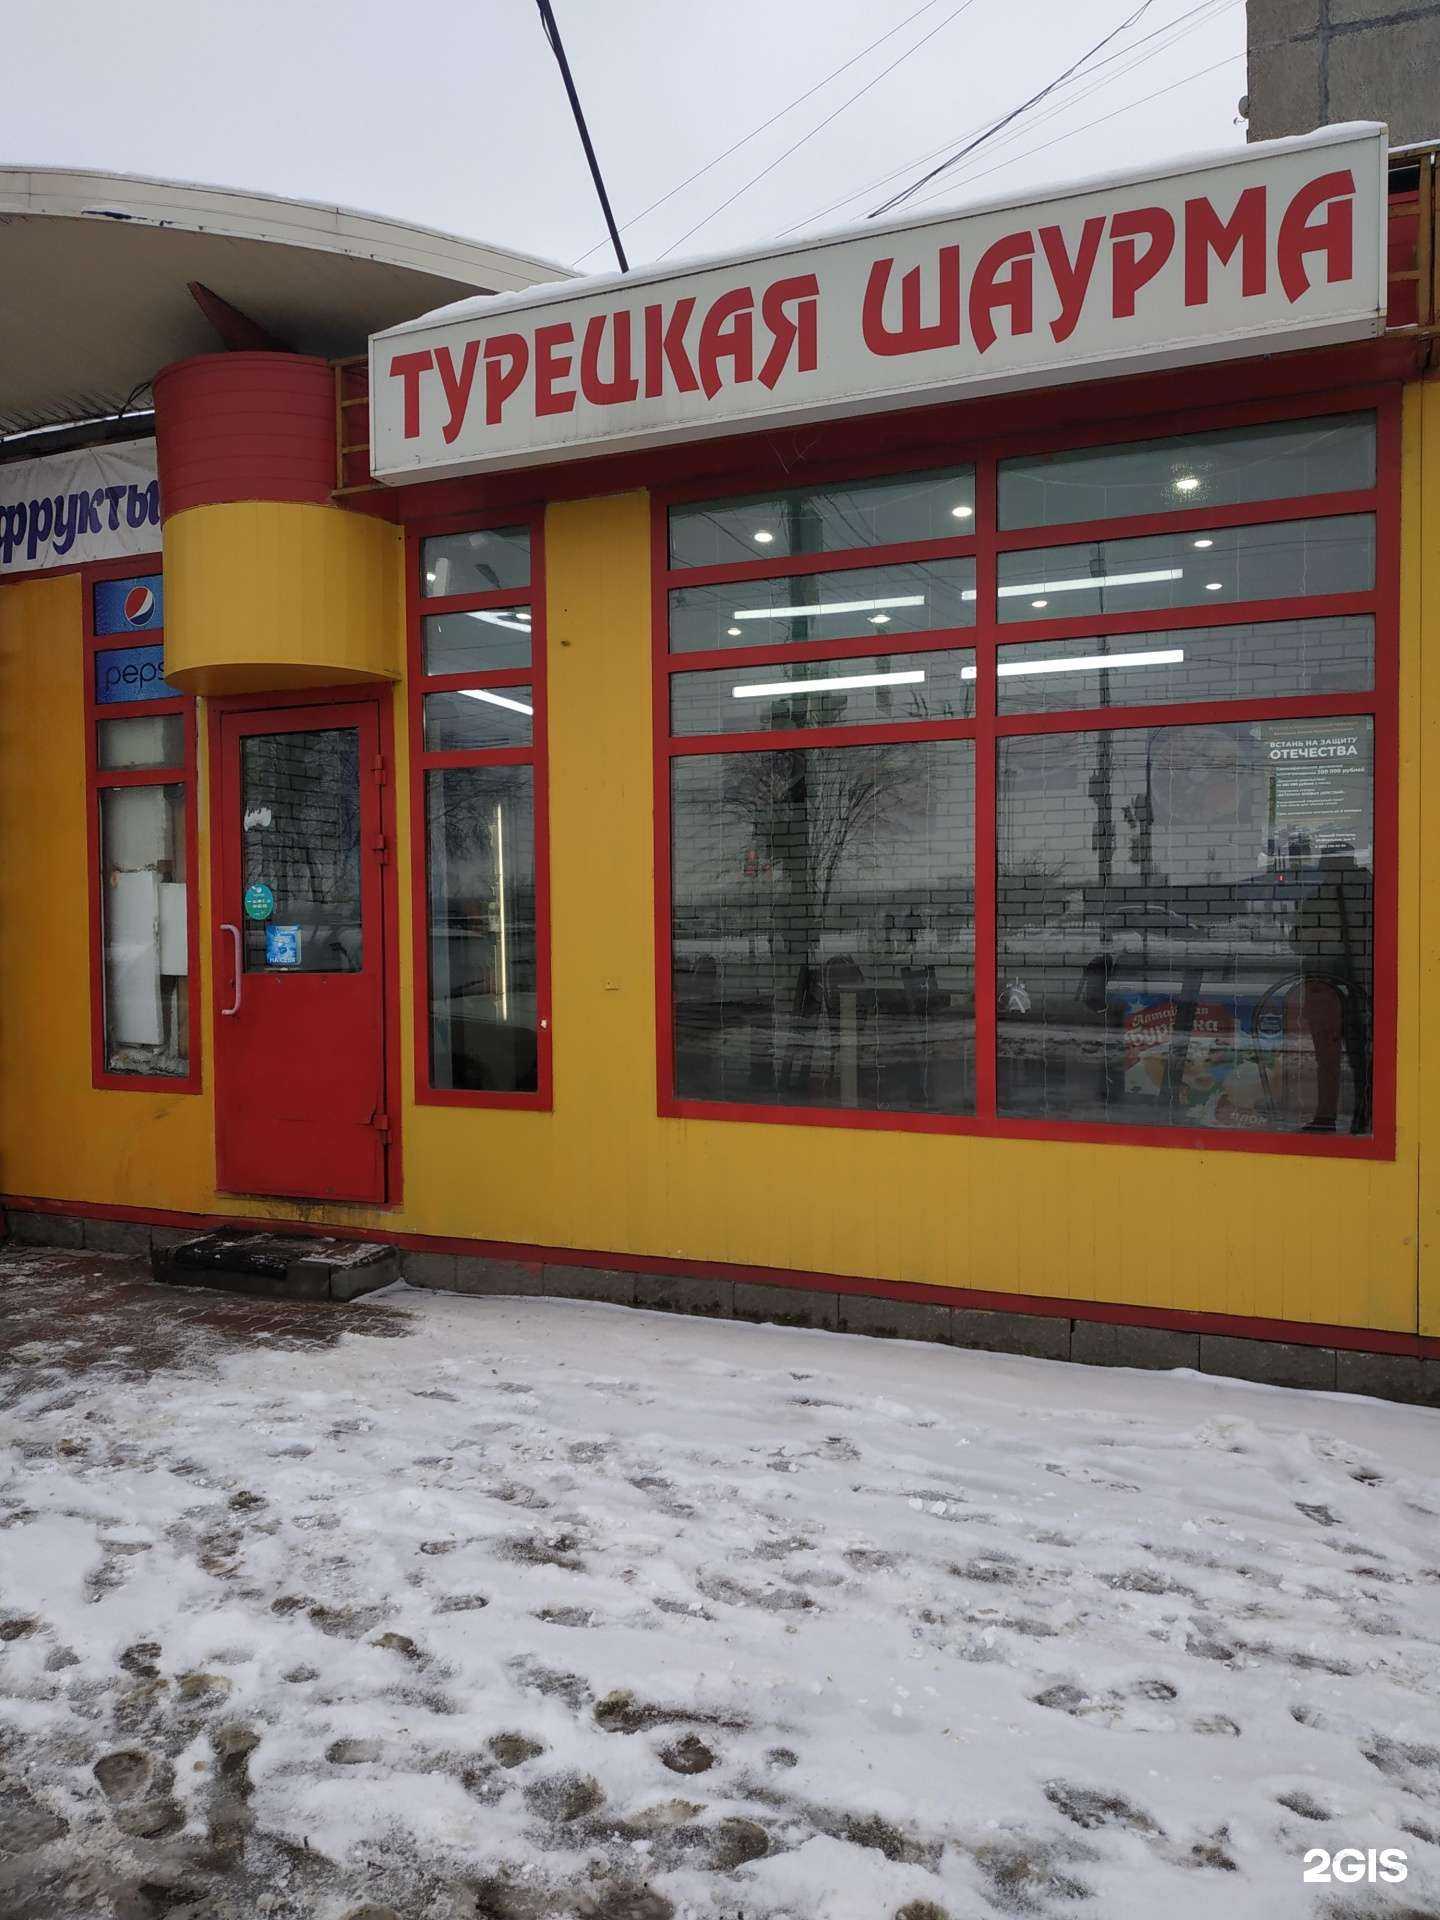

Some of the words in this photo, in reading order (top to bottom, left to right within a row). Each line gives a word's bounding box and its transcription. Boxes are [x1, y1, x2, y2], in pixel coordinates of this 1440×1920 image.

[389, 273, 819, 445] ТУРЕЦКАЯ
[861, 169, 1356, 354] ШАУРМА
[1270, 740, 1304, 748] ВСТАНЬ
[1306, 739, 1318, 747] НА
[1320, 736, 1358, 746] ЗАЩИТУ
[1270, 745, 1358, 760] ОТЕЧЕСТВА
